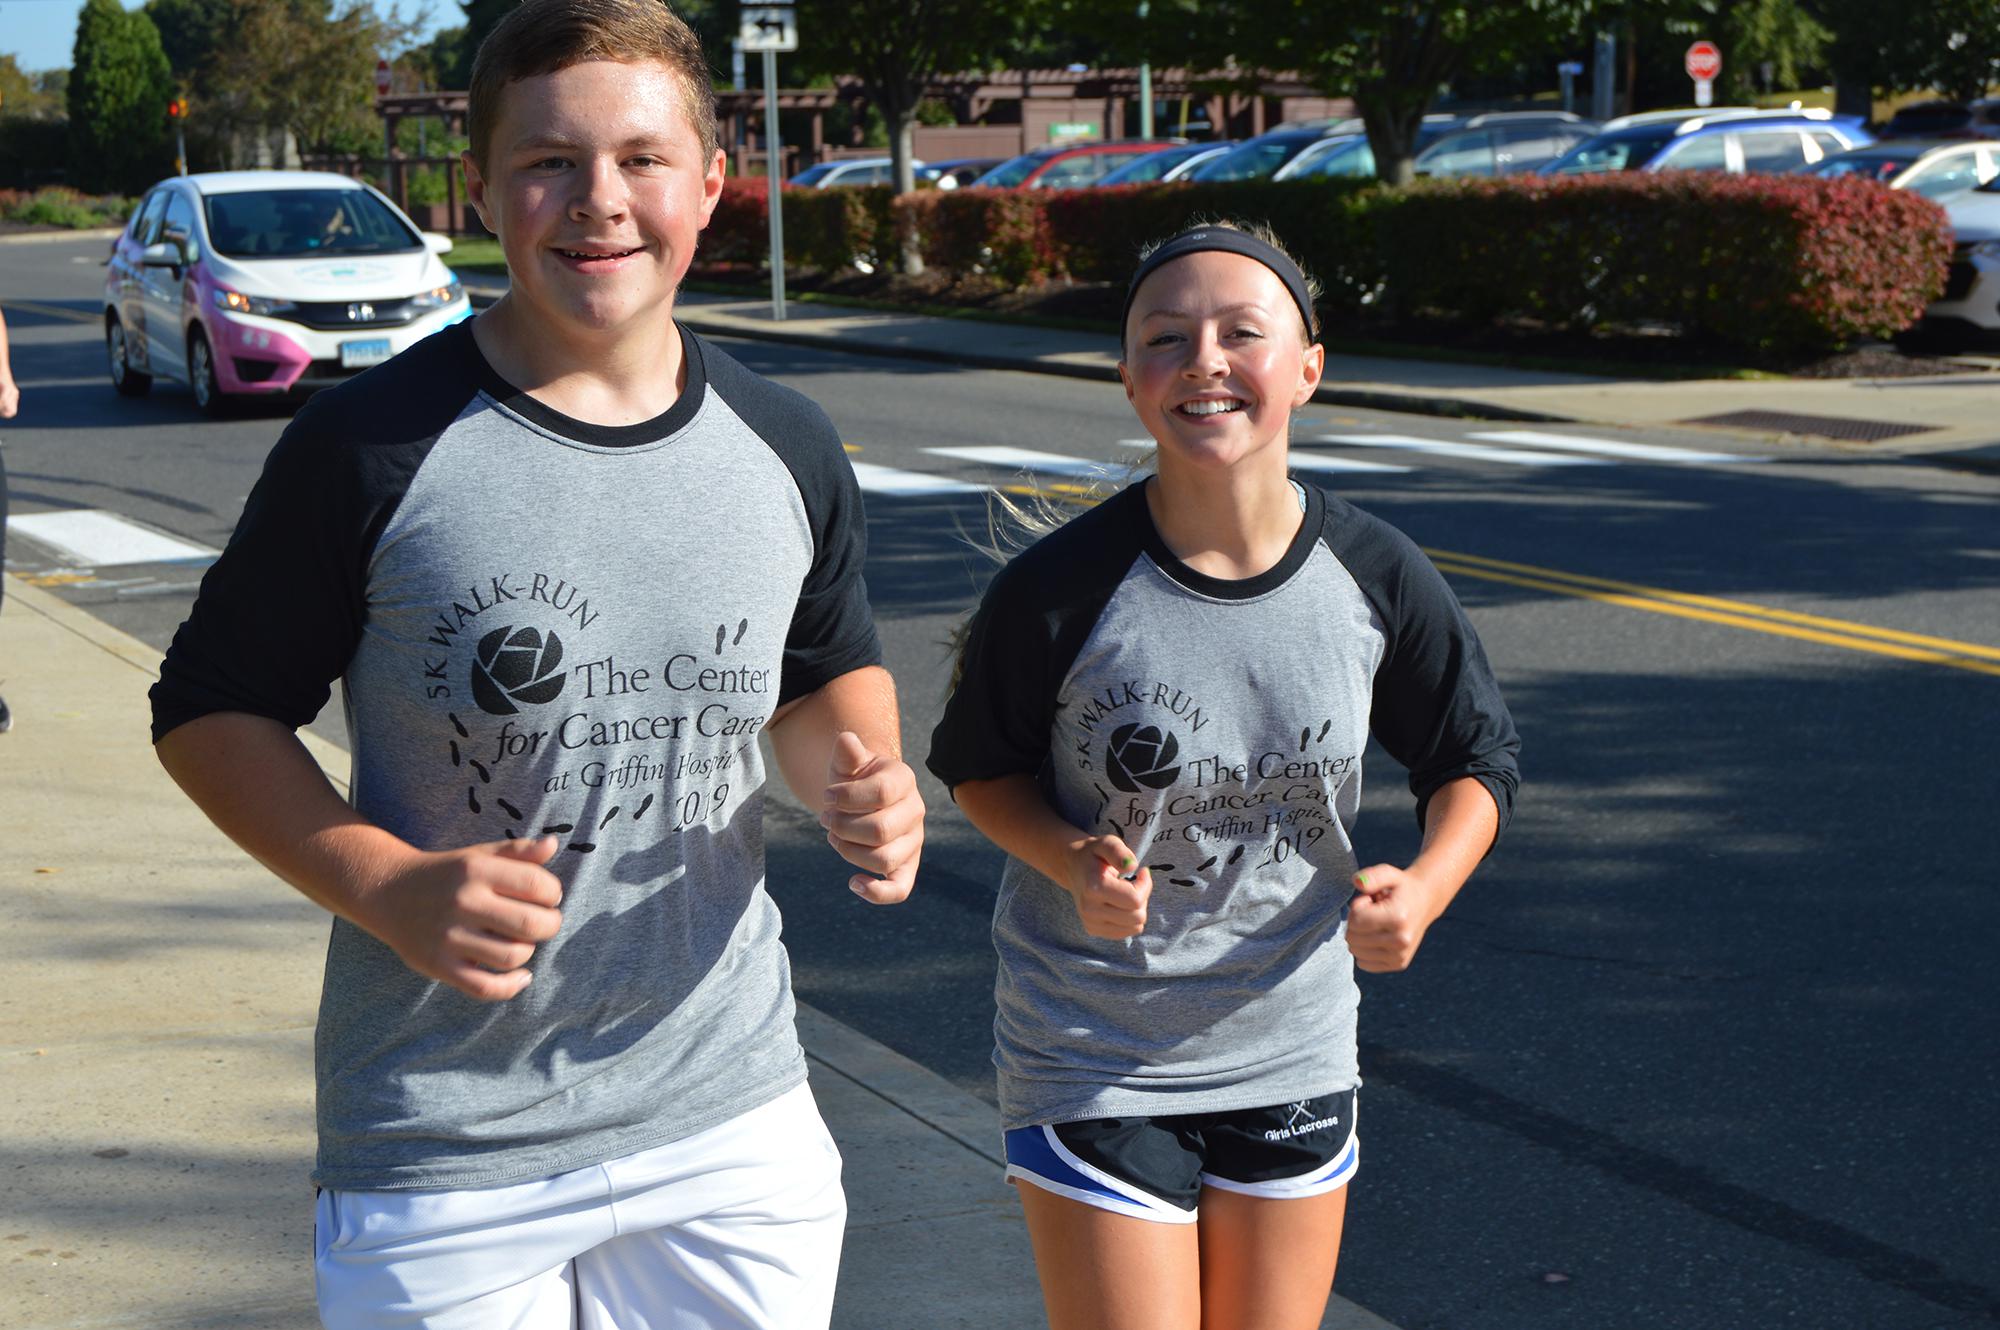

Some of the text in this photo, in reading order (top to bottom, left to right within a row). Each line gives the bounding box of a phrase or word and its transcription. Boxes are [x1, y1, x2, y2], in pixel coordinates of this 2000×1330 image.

[424, 572, 600, 700] 5K WALK-RUN
[575, 654, 770, 699] The Center
[491, 704, 765, 765] for Cancer Care
[1077, 680, 1209, 771] 5K WALK-RUN
[543, 743, 749, 794] at Griffin Hospit
[1188, 752, 1356, 788] The Center
[672, 783, 730, 832] 2019
[1124, 784, 1338, 827] for Cancer Car
[1152, 806, 1337, 844] at Griffin Hspitl
[1255, 826, 1325, 870] 2019
[1265, 1116, 1338, 1141] Girls Lacrosse
